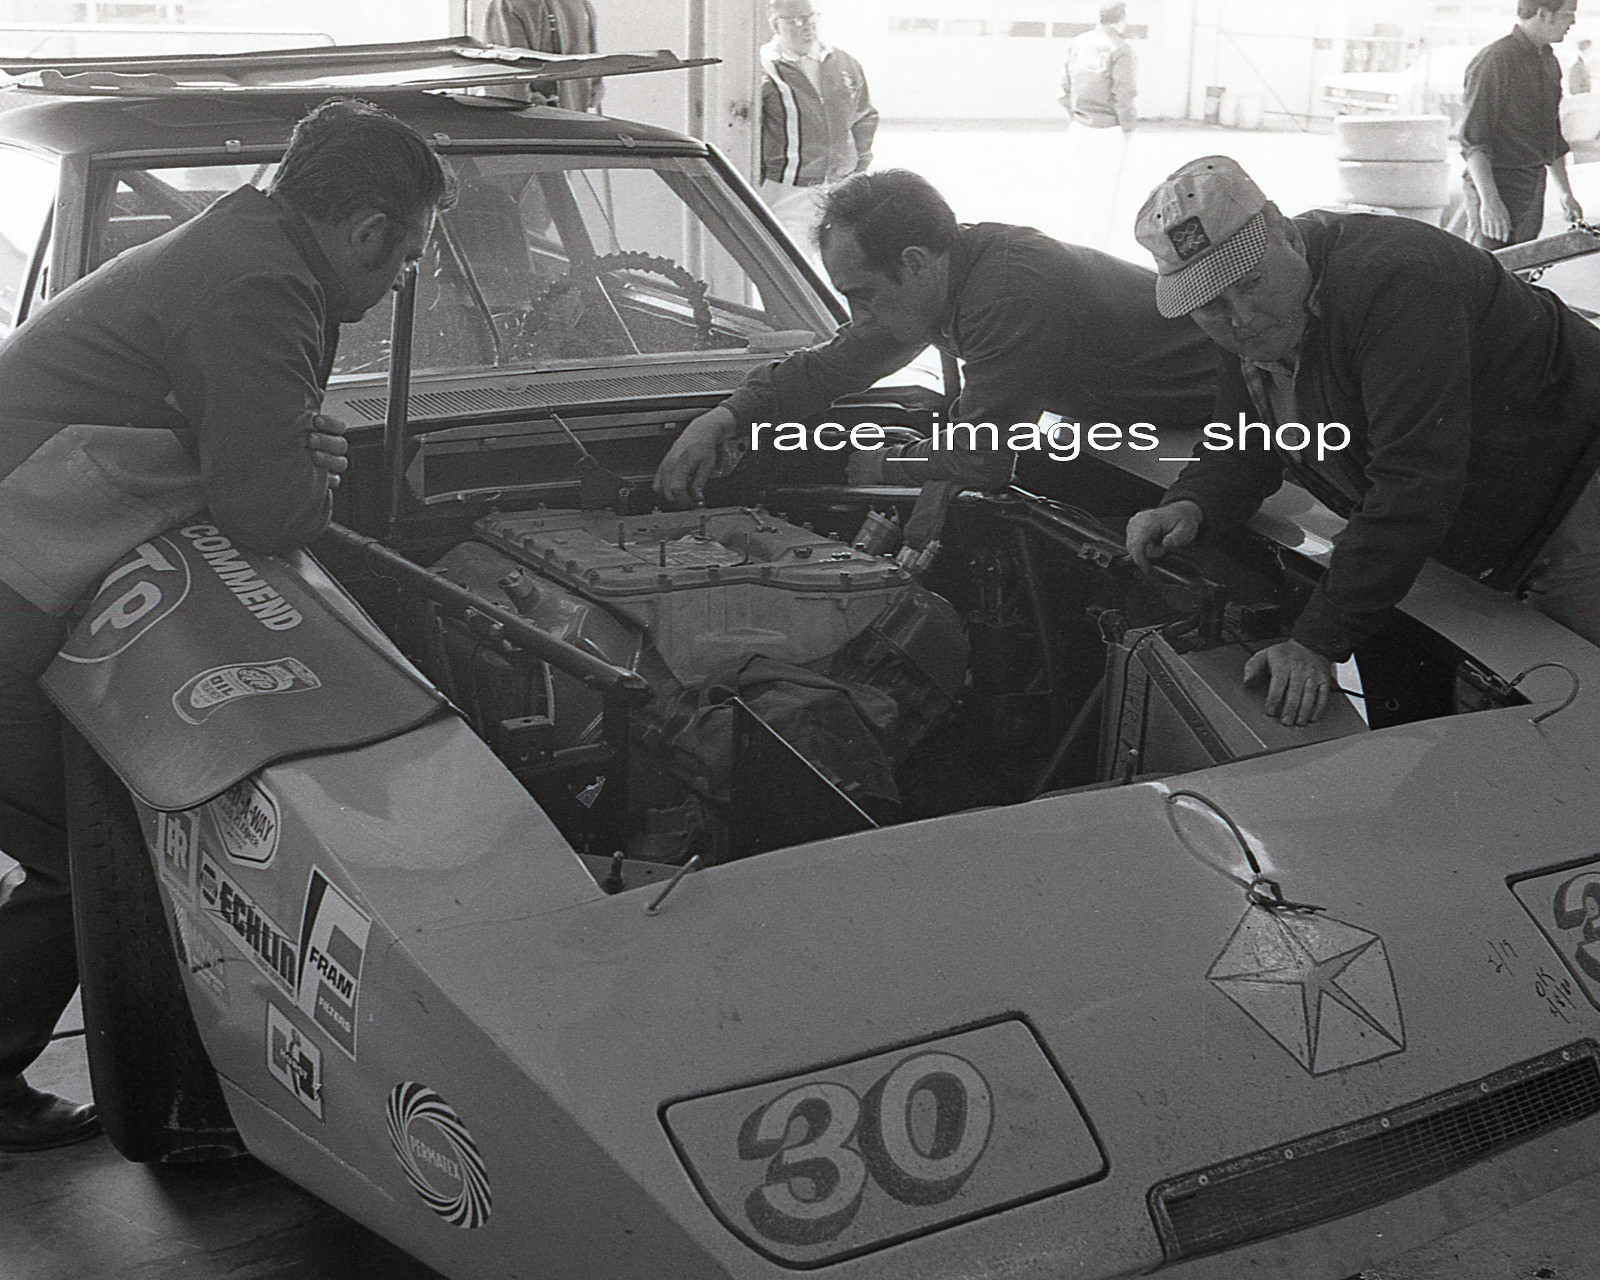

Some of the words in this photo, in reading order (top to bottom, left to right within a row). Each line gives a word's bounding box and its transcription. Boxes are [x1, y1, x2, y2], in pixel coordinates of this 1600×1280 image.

[180, 521, 303, 631] COMMEND
[207, 675, 235, 697] OIL
[309, 946, 354, 999] FRAM
[318, 996, 351, 1034] FILTERS
[737, 1049, 996, 1247] 30
